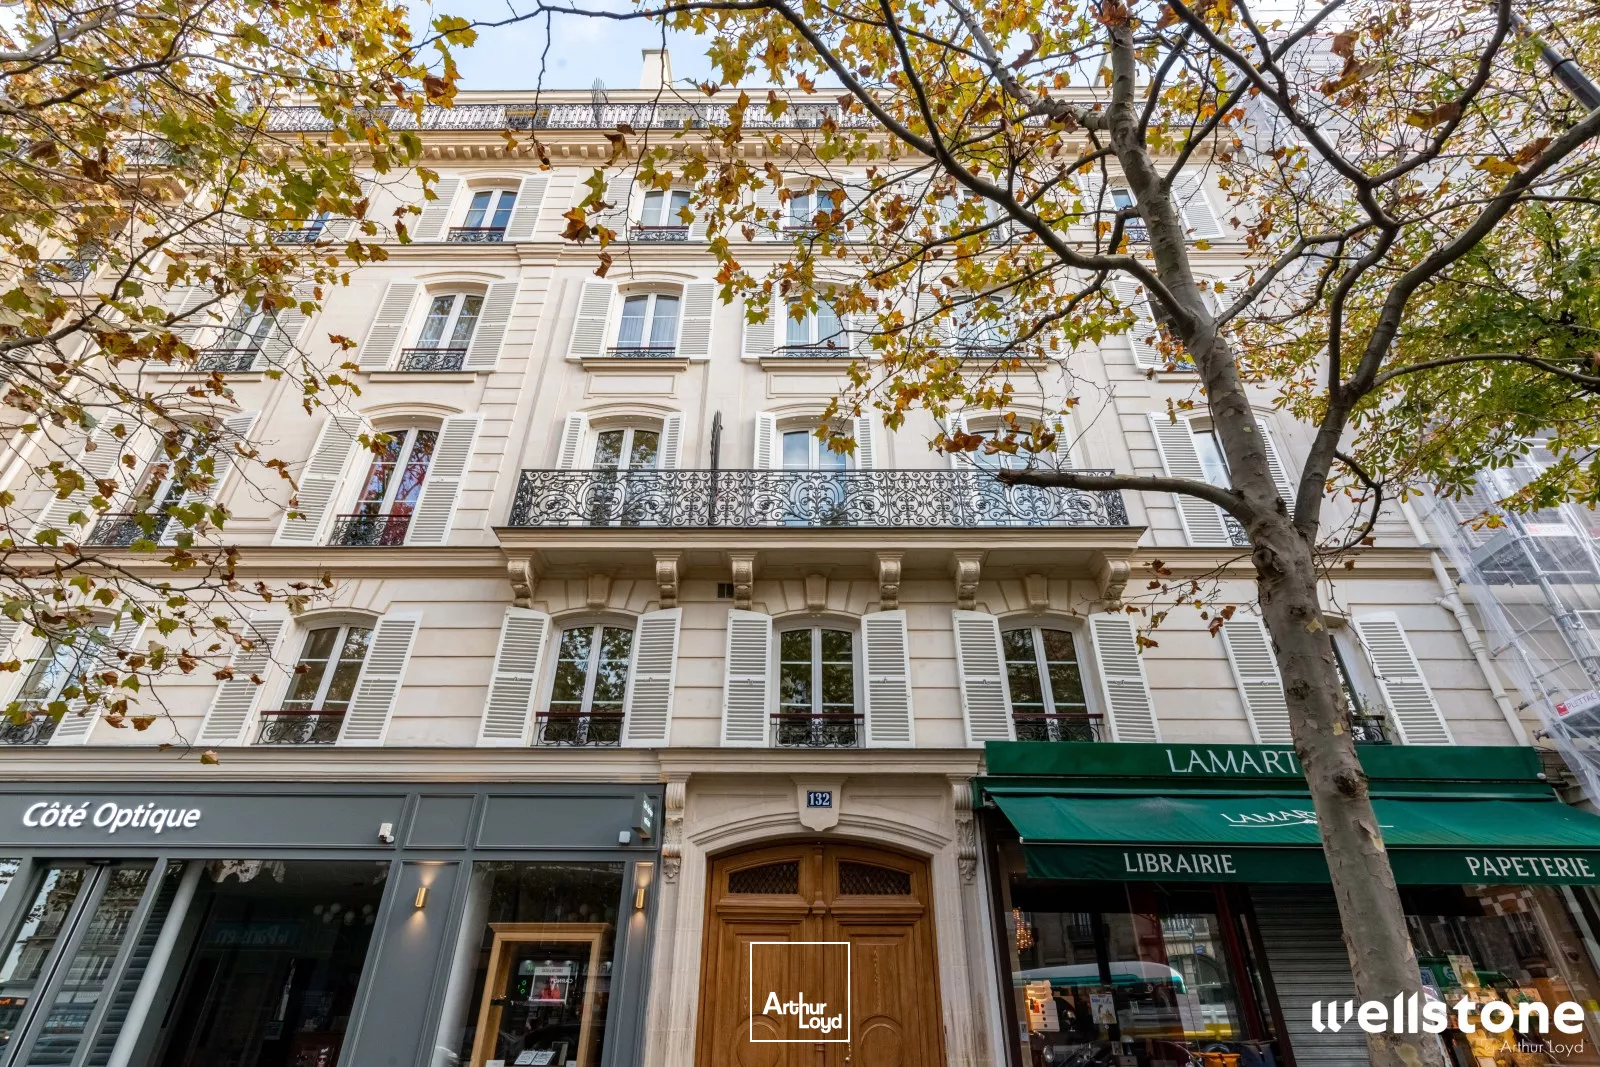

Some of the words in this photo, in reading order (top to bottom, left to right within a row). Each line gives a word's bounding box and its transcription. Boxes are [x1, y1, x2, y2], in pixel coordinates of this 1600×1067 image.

[1166, 750, 1298, 774] LAMART
[809, 792, 830, 806] 132
[22, 801, 91, 828] Côté
[93, 802, 201, 834] Optique
[1123, 852, 1237, 874] LIBRAIRIE
[1465, 856, 1596, 877] PAPETERIE
